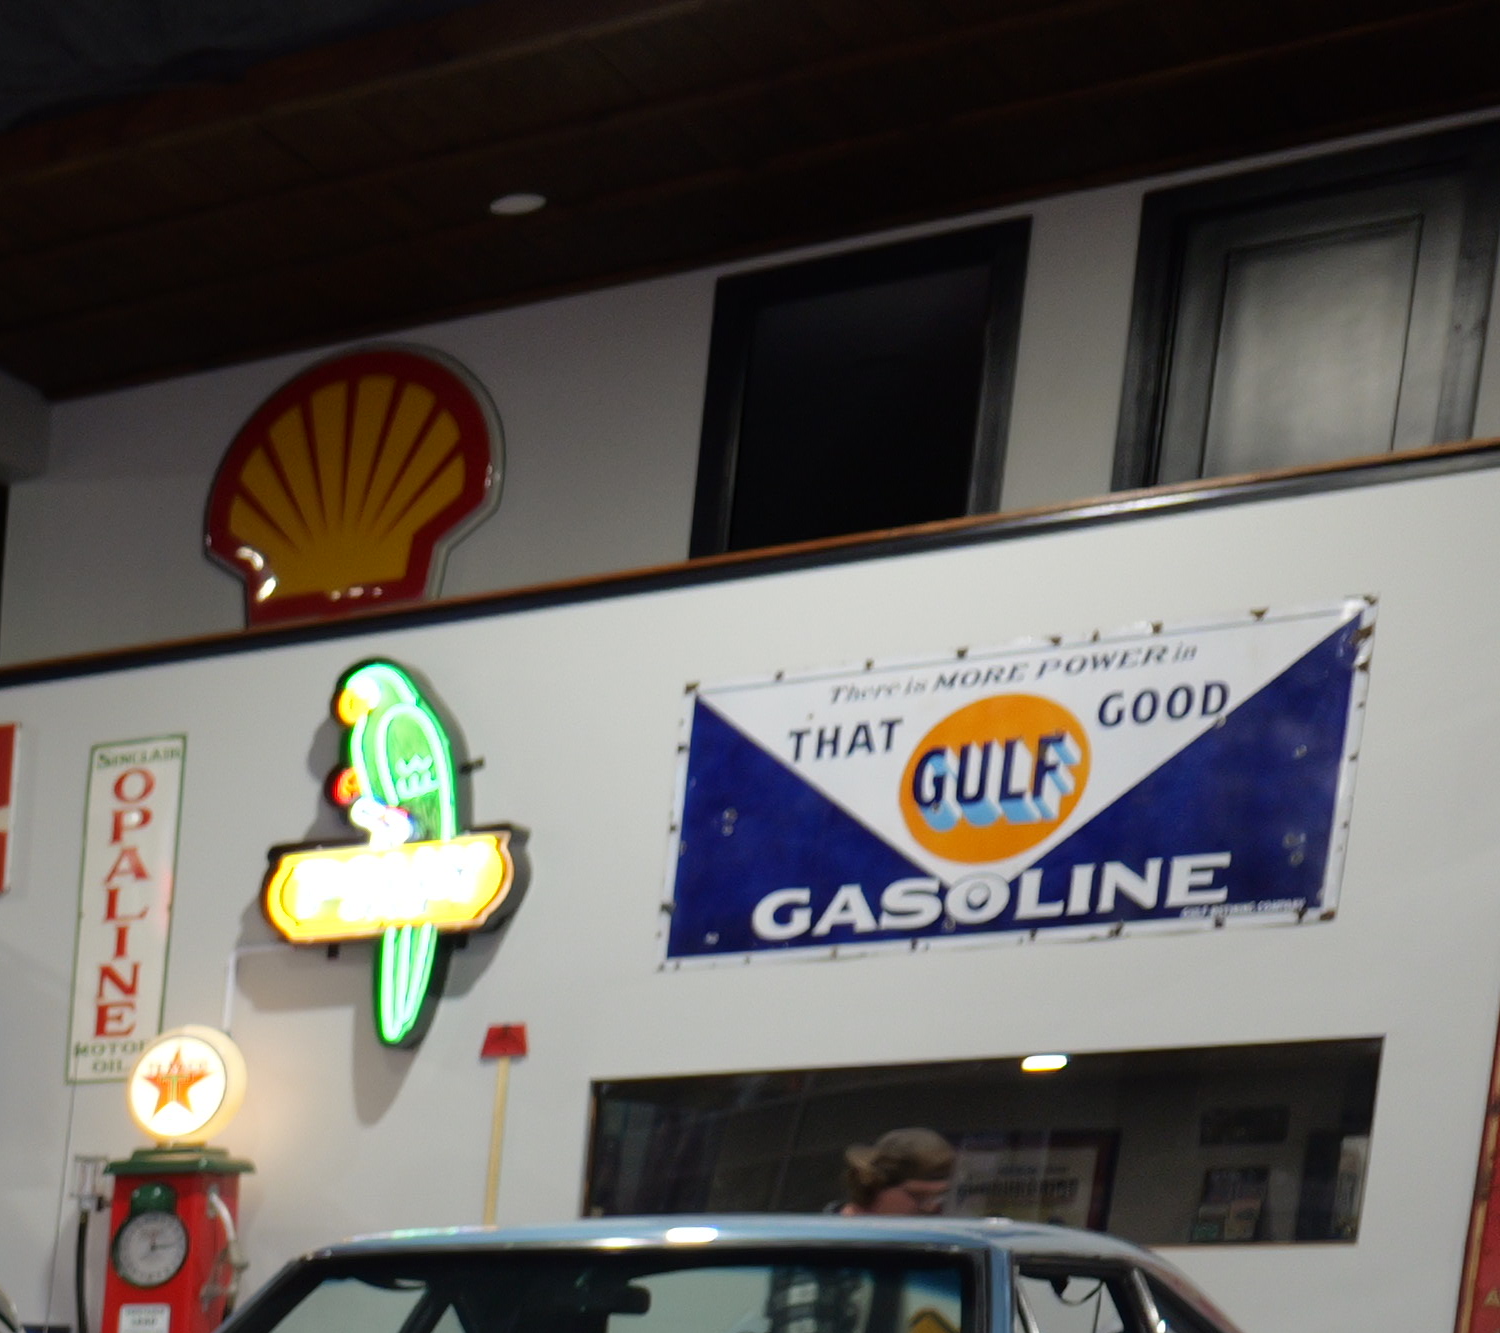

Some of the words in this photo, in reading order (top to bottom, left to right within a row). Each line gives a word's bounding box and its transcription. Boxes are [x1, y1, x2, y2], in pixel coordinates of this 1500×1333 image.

[830, 681, 900, 705] There
[903, 678, 925, 698] is
[931, 661, 1028, 694] MORE
[1035, 645, 1170, 683] POWER
[1171, 639, 1199, 664] in
[1098, 681, 1230, 729] GOOD
[789, 717, 904, 764] THAT
[911, 732, 1083, 832] GULF
[93, 769, 156, 1039] OPALINE
[751, 852, 1232, 942] GASOLINE
